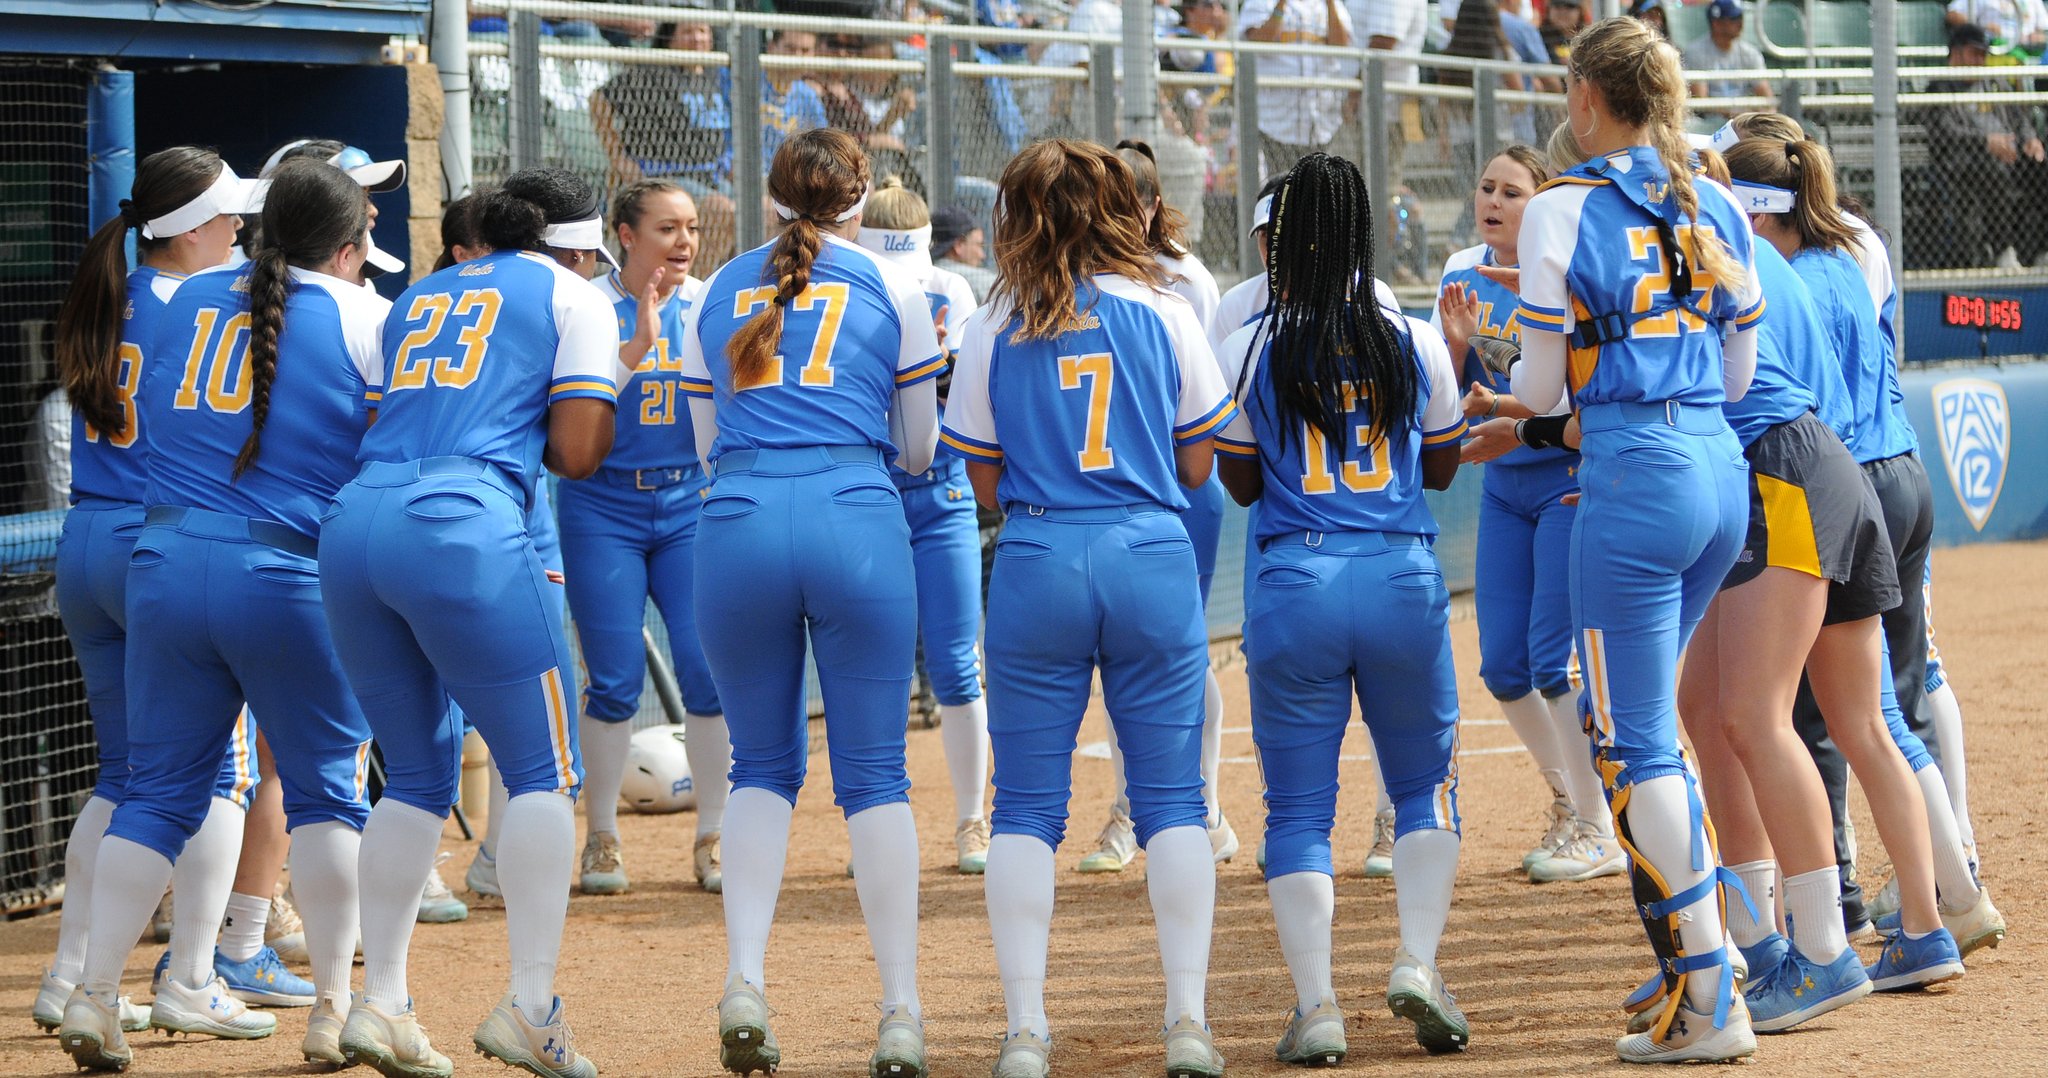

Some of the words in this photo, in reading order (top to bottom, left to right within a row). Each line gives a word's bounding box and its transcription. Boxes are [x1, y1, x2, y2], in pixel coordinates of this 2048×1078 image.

[884, 234, 917, 252] Ucla
[173, 308, 254, 414] 10
[387, 287, 504, 394] 23
[640, 381, 676, 425] 21
[1056, 352, 1115, 472] 7
[1963, 455, 1992, 499] 12
